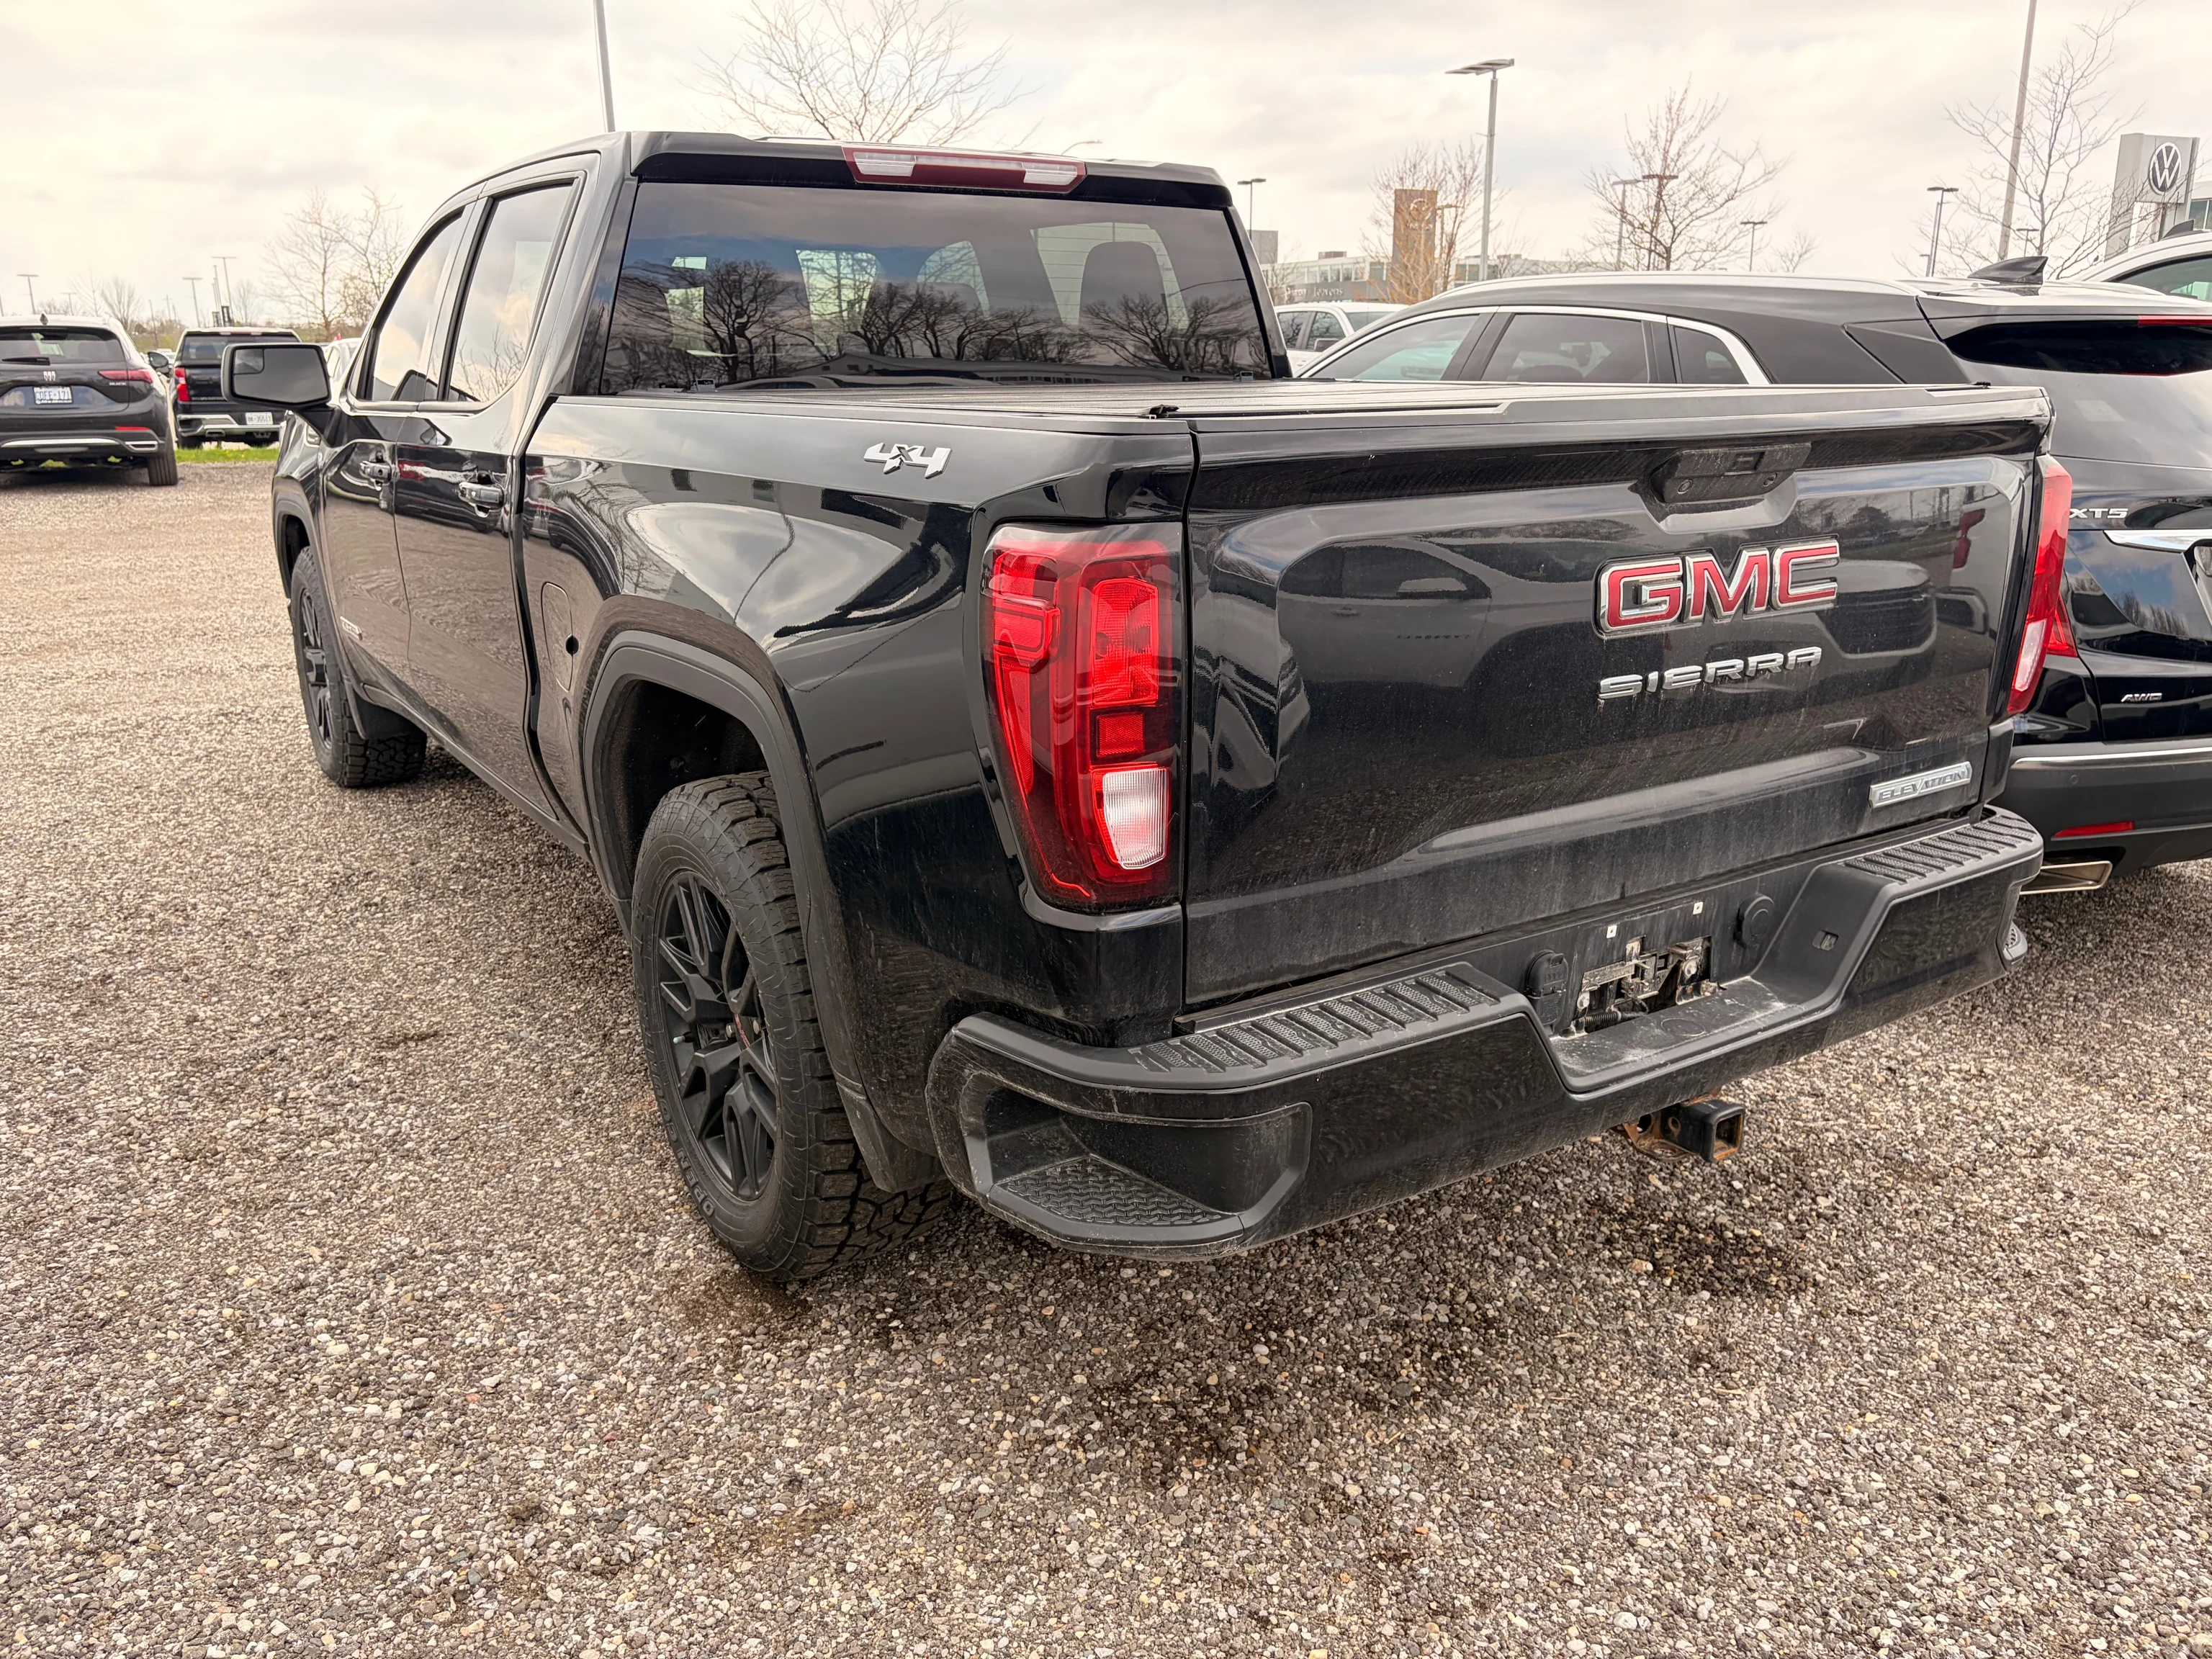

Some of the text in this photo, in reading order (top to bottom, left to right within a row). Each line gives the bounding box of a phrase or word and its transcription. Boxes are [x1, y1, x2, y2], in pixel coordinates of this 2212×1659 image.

[2069, 507, 2128, 519] XT5
[1597, 537, 1840, 637] GMC
[1597, 645, 1823, 700] SIERRA
[2120, 692, 2163, 703] AWD
[1878, 767, 1966, 801] ELEVATION
